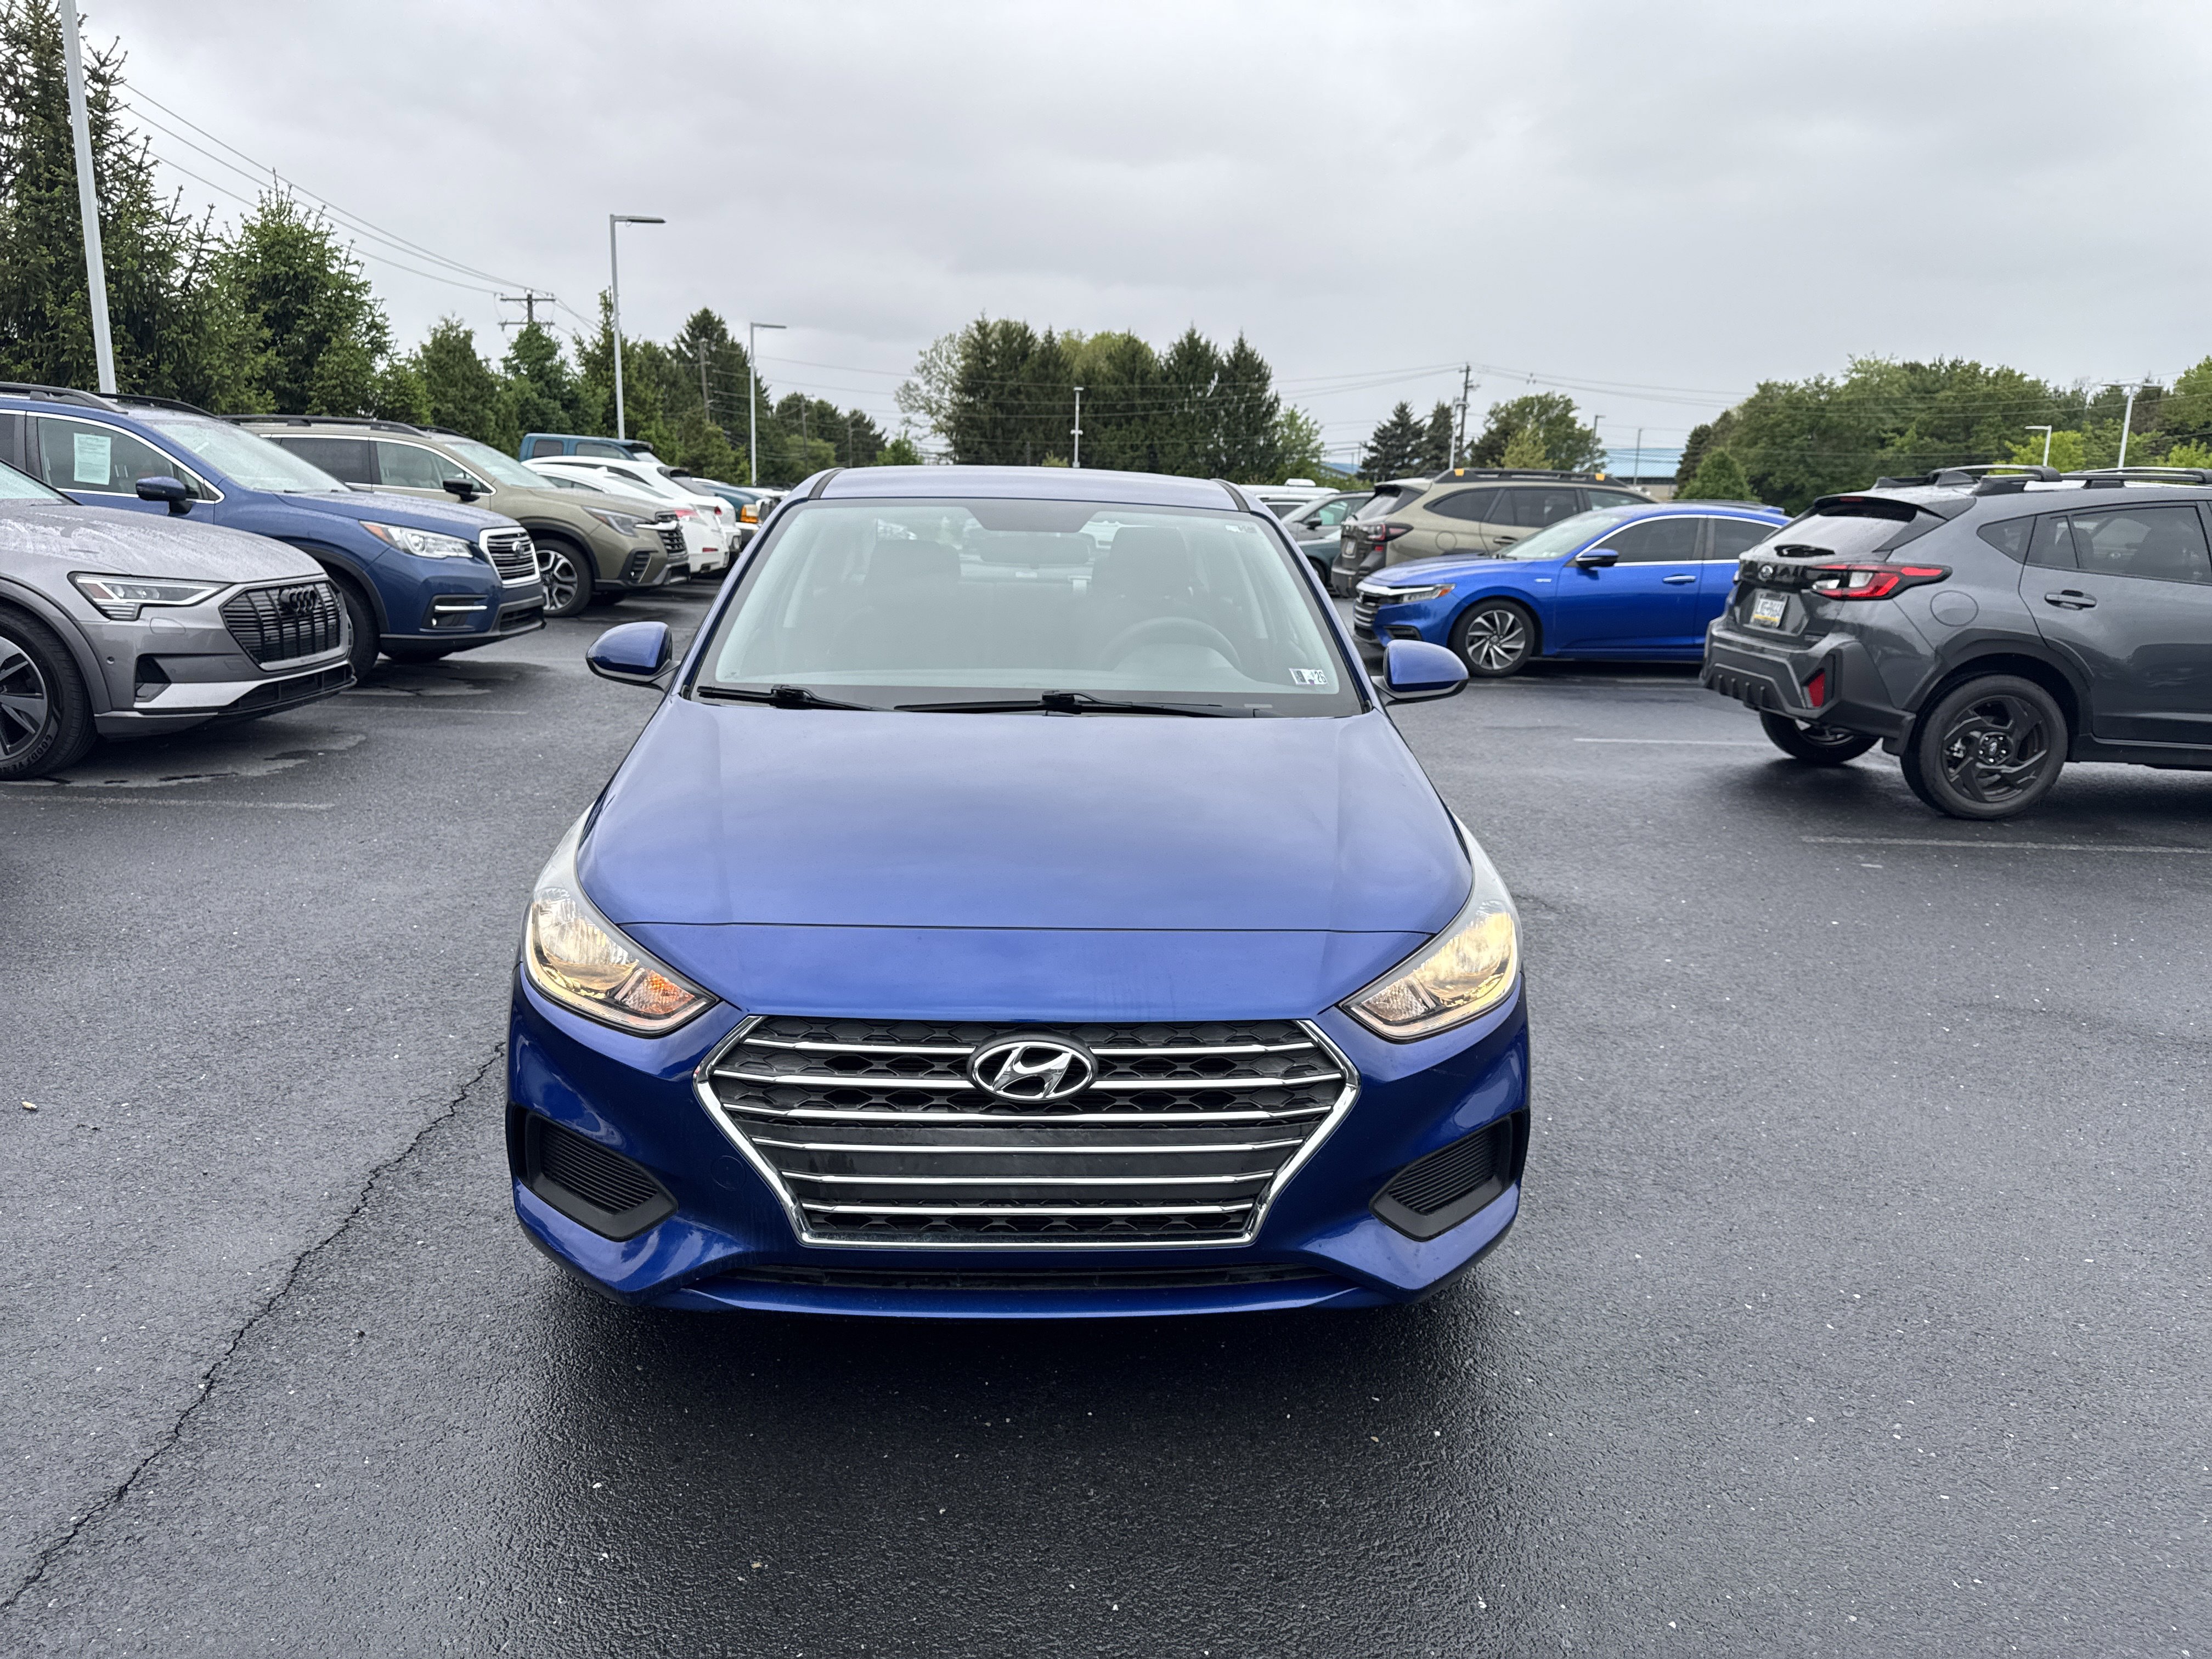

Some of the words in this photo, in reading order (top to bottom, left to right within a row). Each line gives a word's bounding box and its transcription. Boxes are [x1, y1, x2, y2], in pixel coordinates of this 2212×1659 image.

[1296, 670, 1306, 682] 9
[1314, 671, 1327, 682] 26
[0, 735, 53, 773] GOODYE
